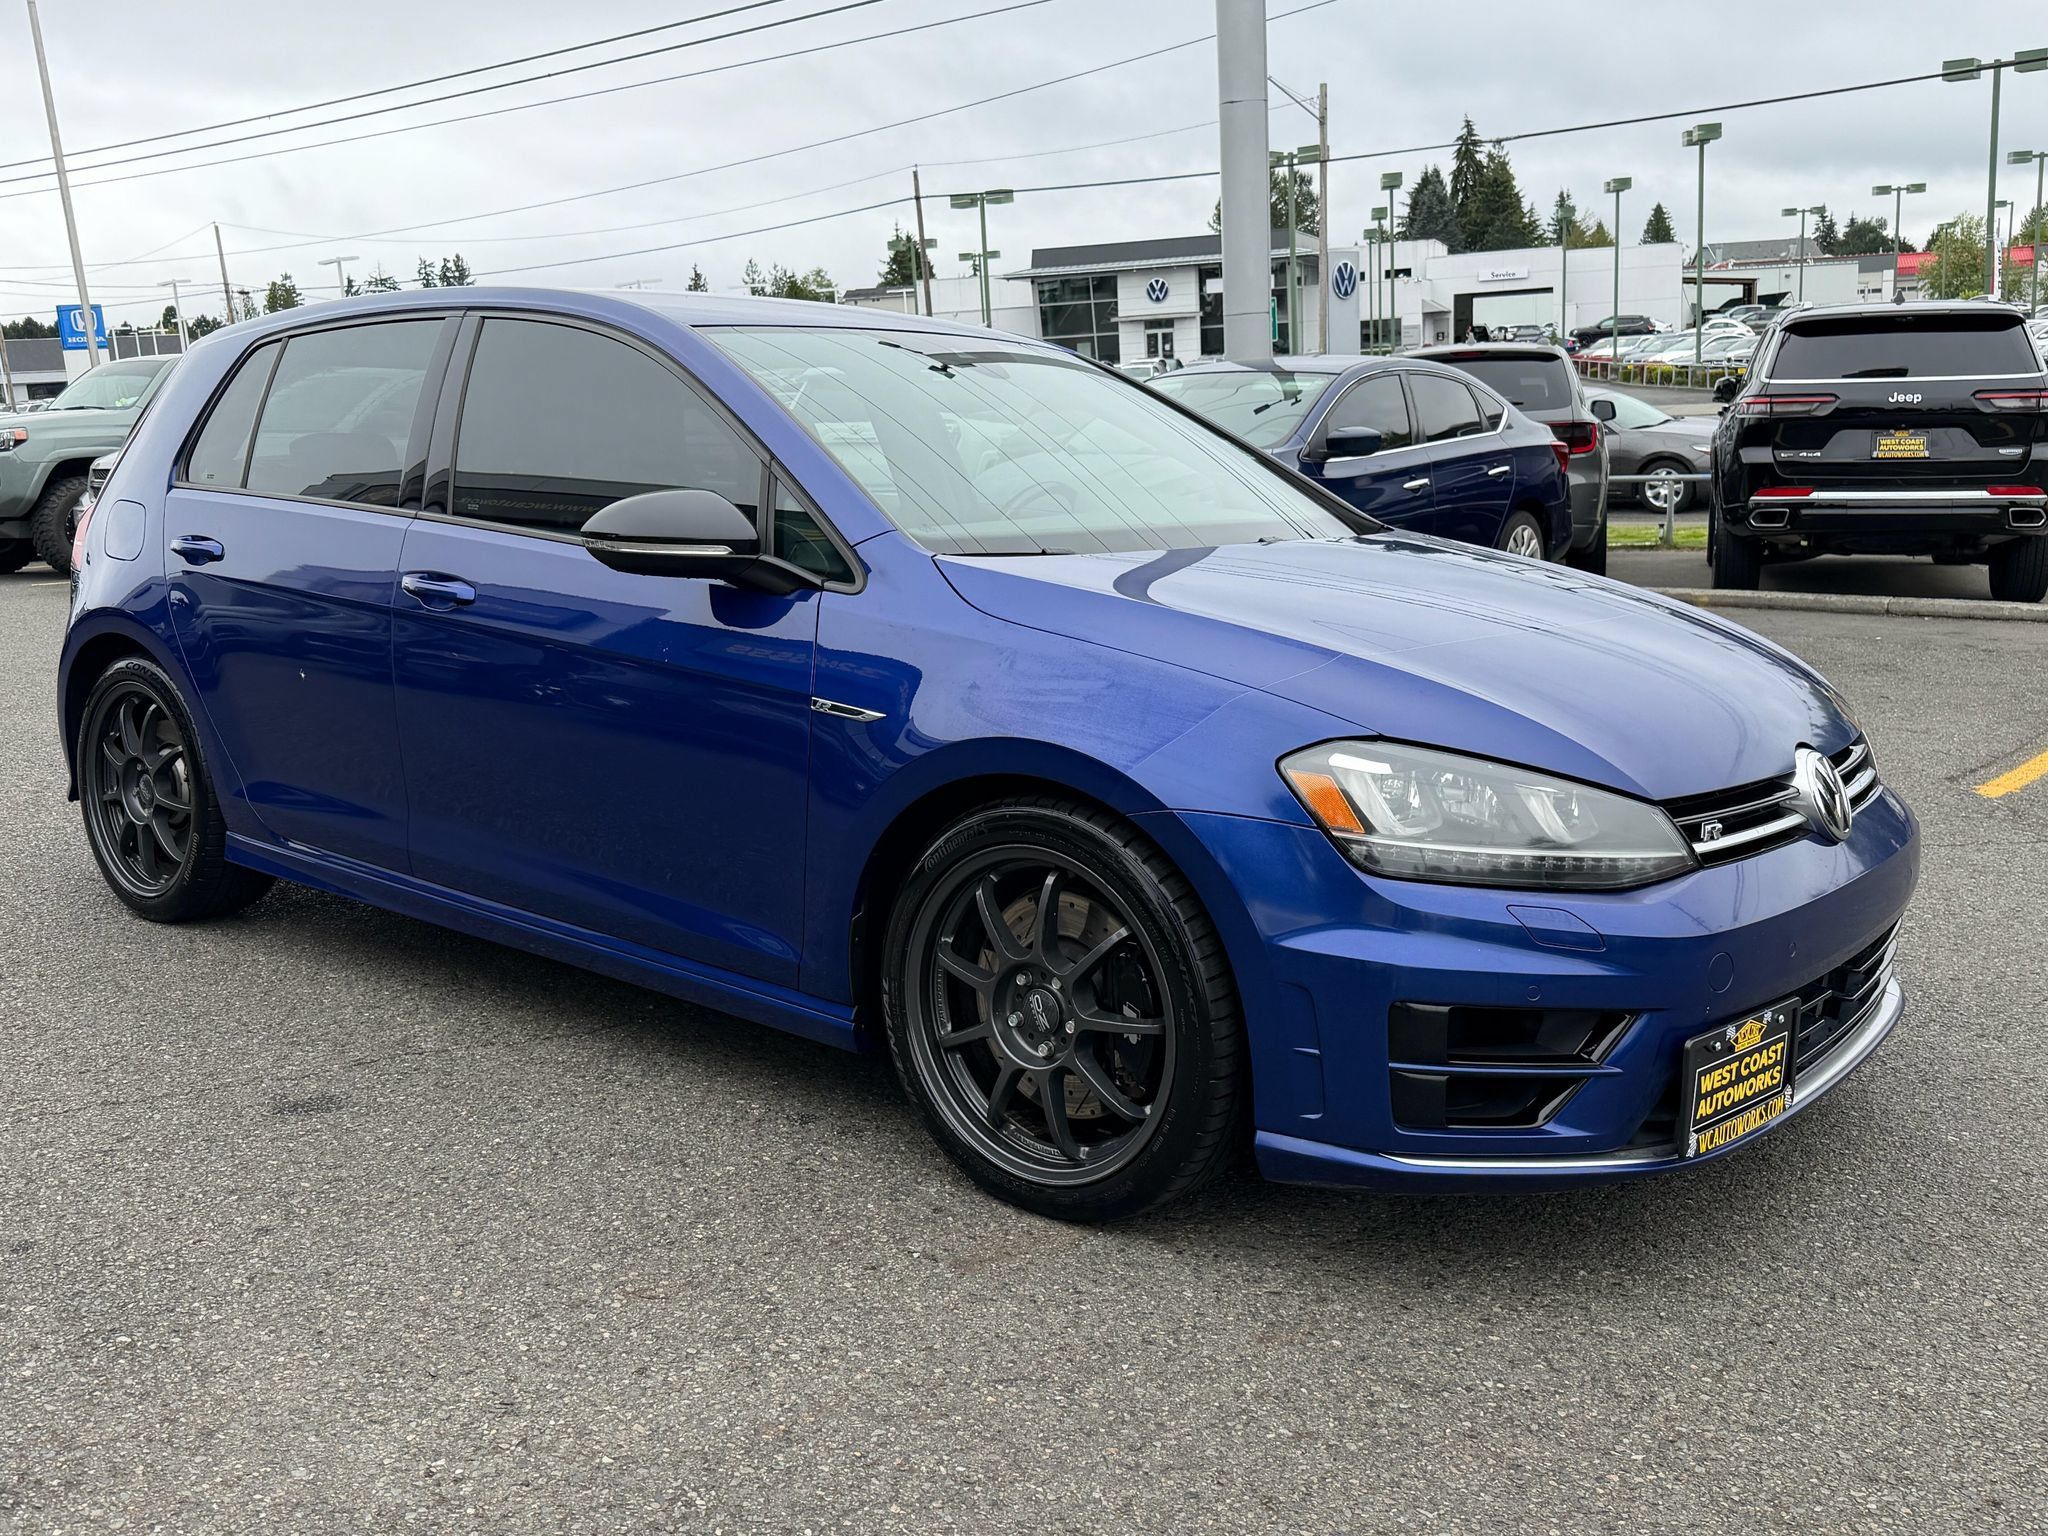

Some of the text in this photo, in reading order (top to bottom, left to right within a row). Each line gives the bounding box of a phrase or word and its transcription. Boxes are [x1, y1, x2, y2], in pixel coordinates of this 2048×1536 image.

[1889, 392, 1922, 404] Jeep
[924, 823, 982, 872] Continental
[1701, 820, 1723, 841] R
[1696, 1065, 1782, 1119] AUTOWORKS
[1700, 1042, 1784, 1094] WEST COAST
[1698, 1094, 1785, 1154] WCAUTOWORKS.COM
